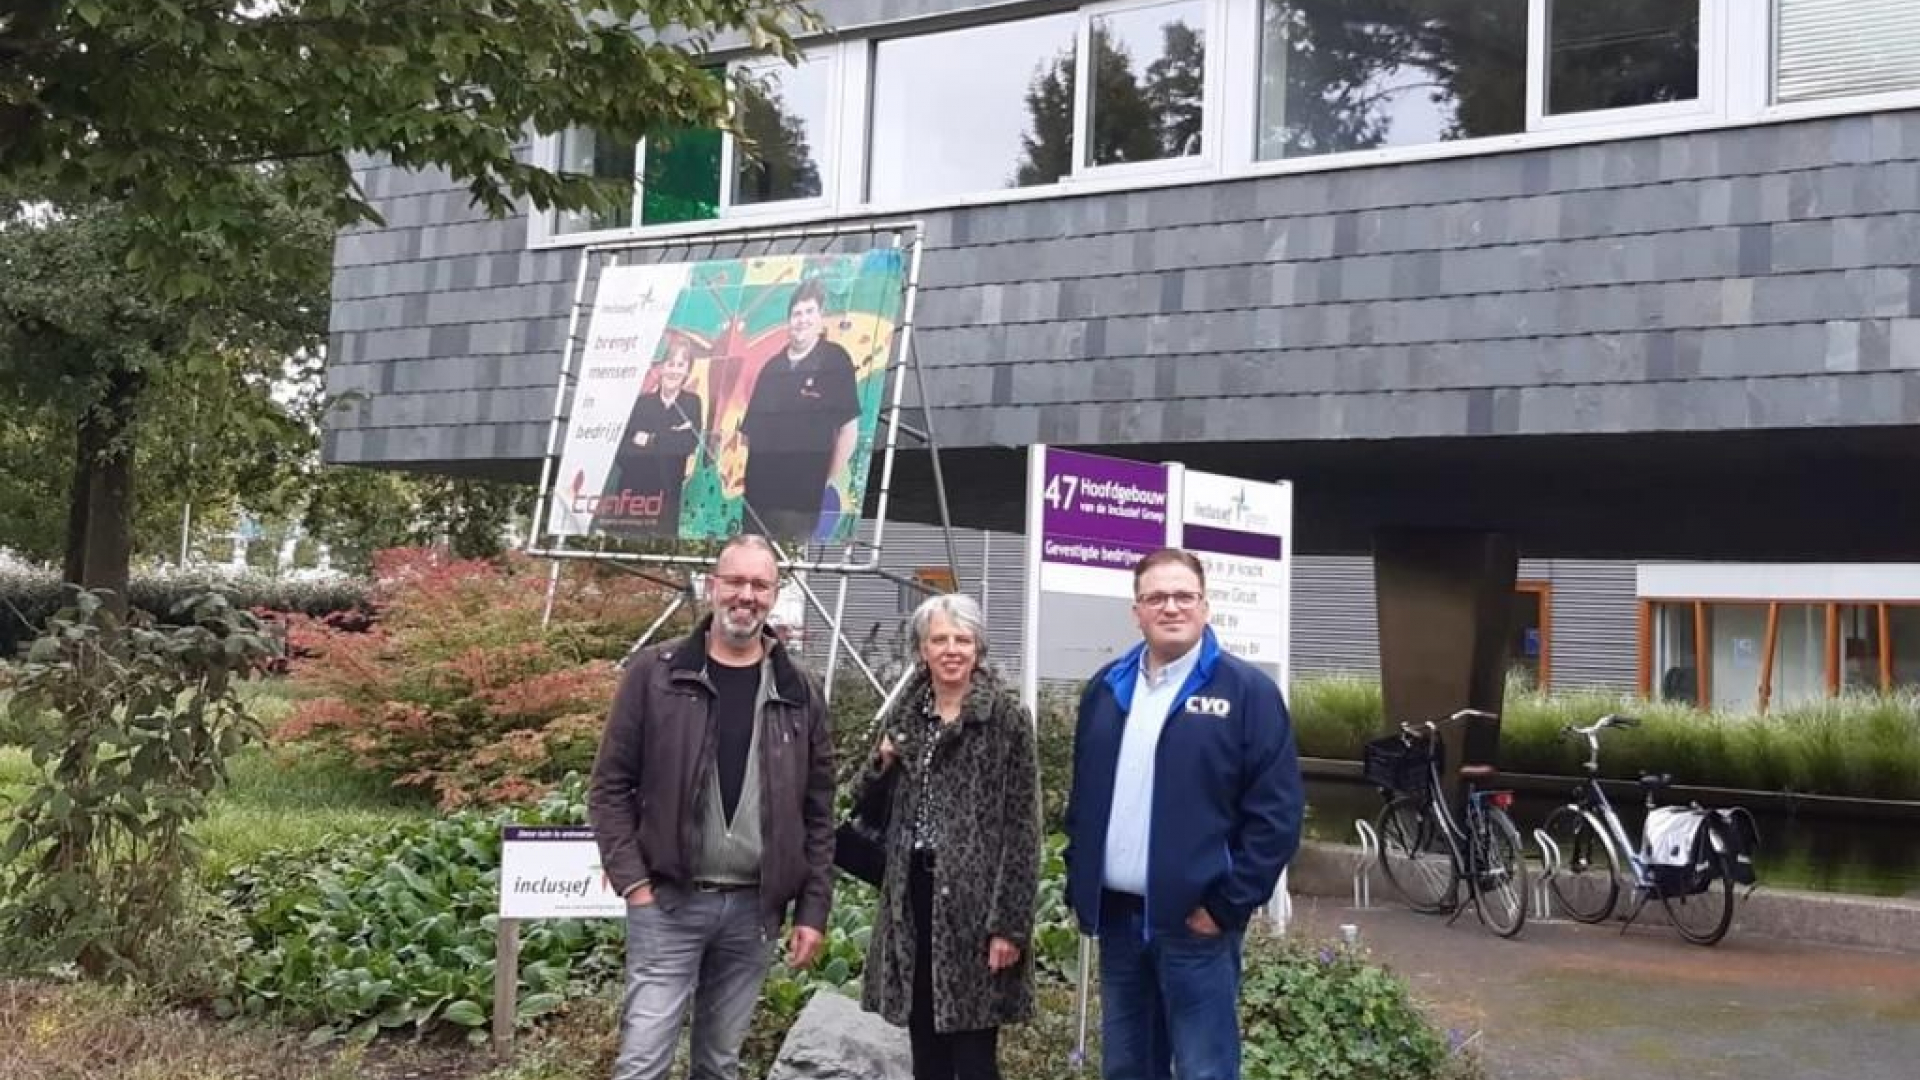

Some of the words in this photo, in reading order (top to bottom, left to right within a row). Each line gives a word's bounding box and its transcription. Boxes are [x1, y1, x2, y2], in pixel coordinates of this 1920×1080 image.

[594, 335, 638, 352] brengt
[589, 366, 638, 379] mensen
[575, 423, 622, 443] bedrijf
[1044, 473, 1078, 511] 47
[1081, 477, 1165, 505] Hoofdgebouw
[1045, 539, 1100, 563] Gevestigde
[1184, 696, 1231, 717] CVO
[513, 875, 592, 898] inclusief
